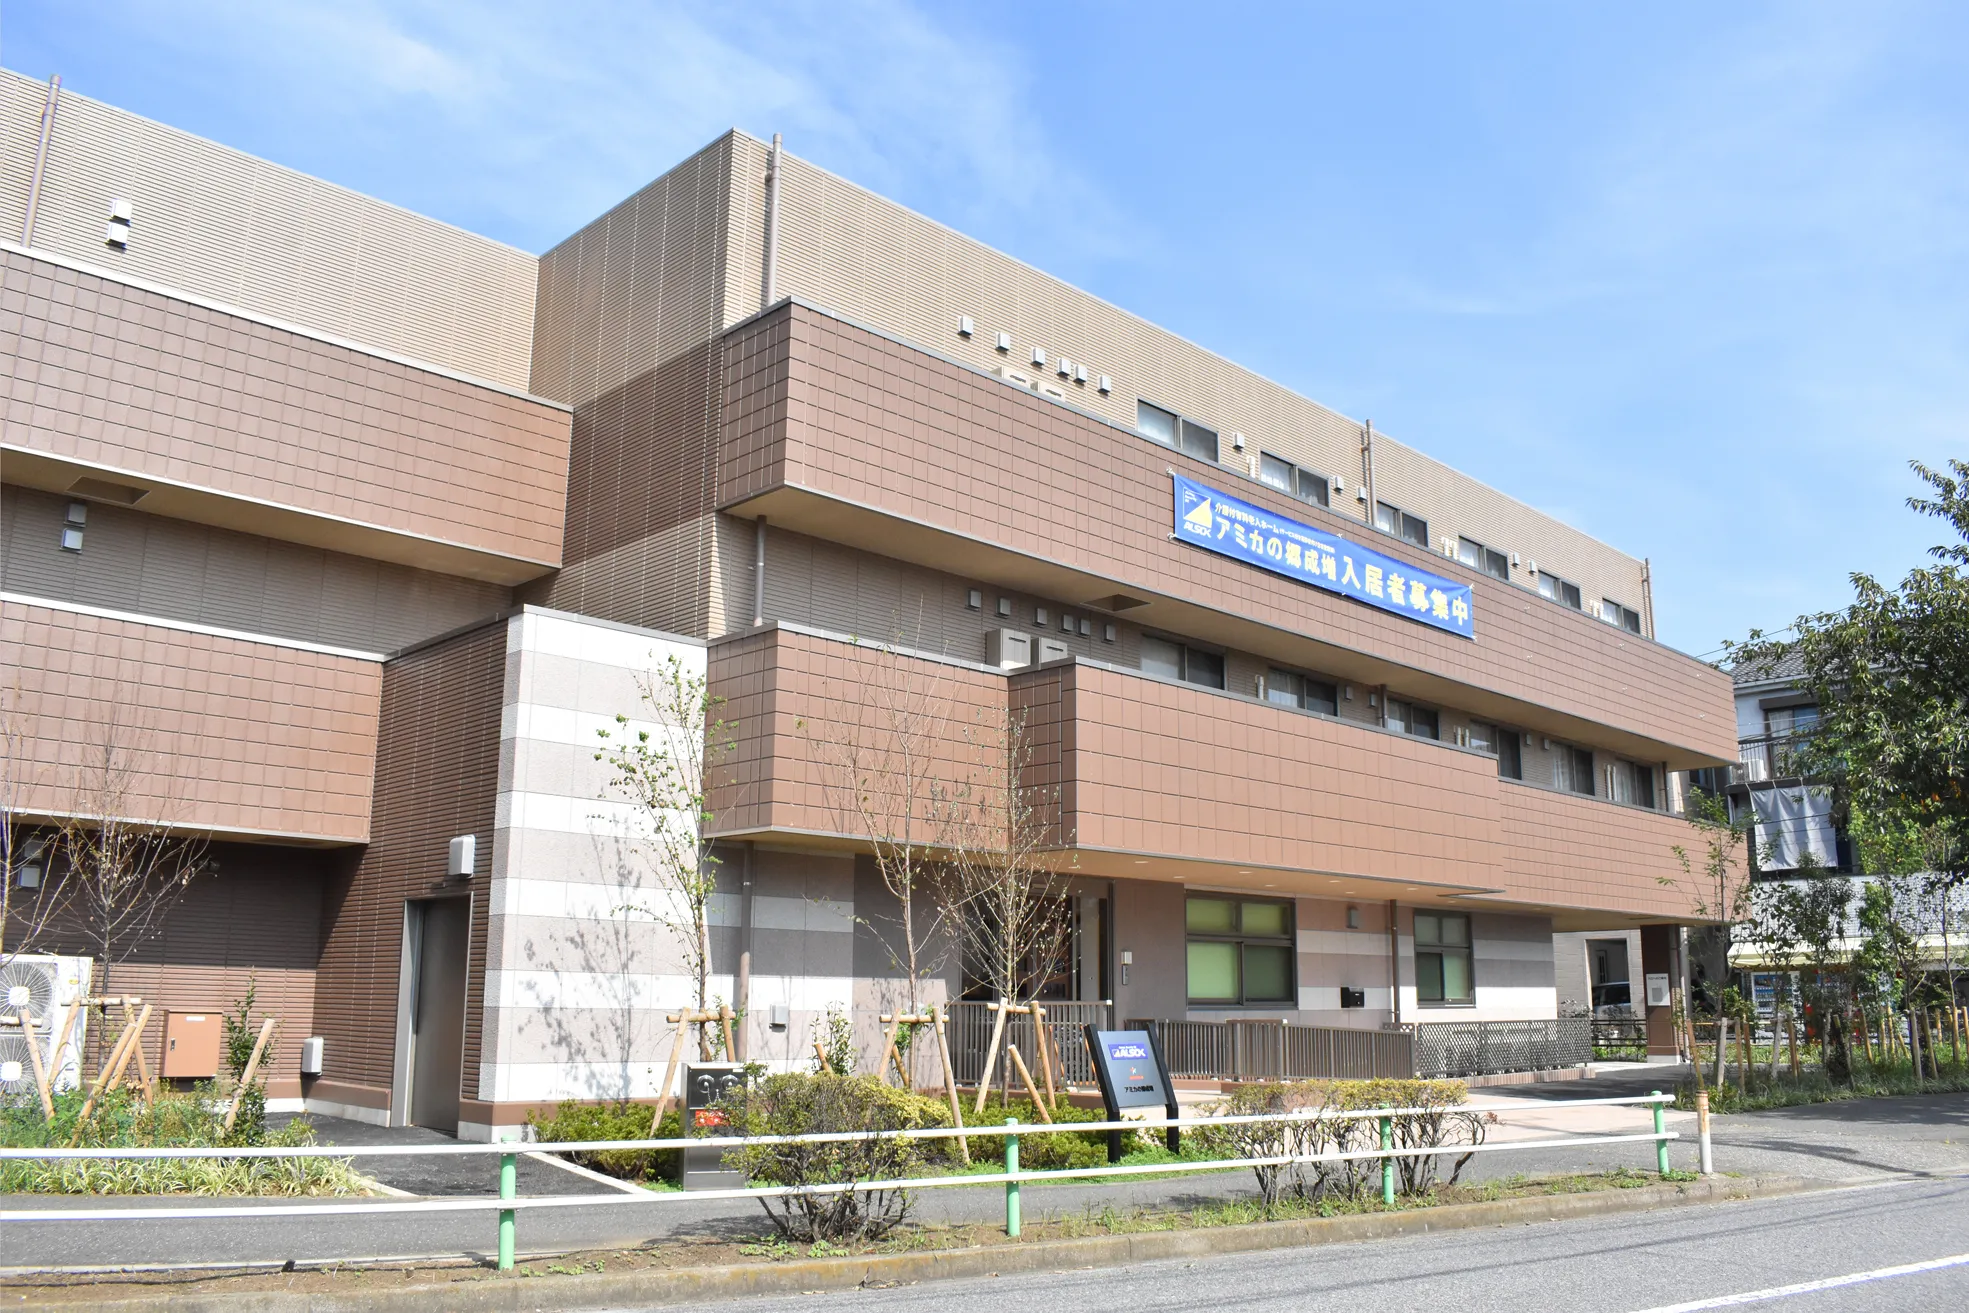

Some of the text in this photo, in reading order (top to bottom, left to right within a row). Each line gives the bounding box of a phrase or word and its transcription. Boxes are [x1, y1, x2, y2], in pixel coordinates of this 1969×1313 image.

[1183, 521, 1212, 539] ALSOK
[1215, 516, 1468, 626] アミカの郷成増 入居者募集中
[1120, 1048, 1146, 1058] ALSOK
